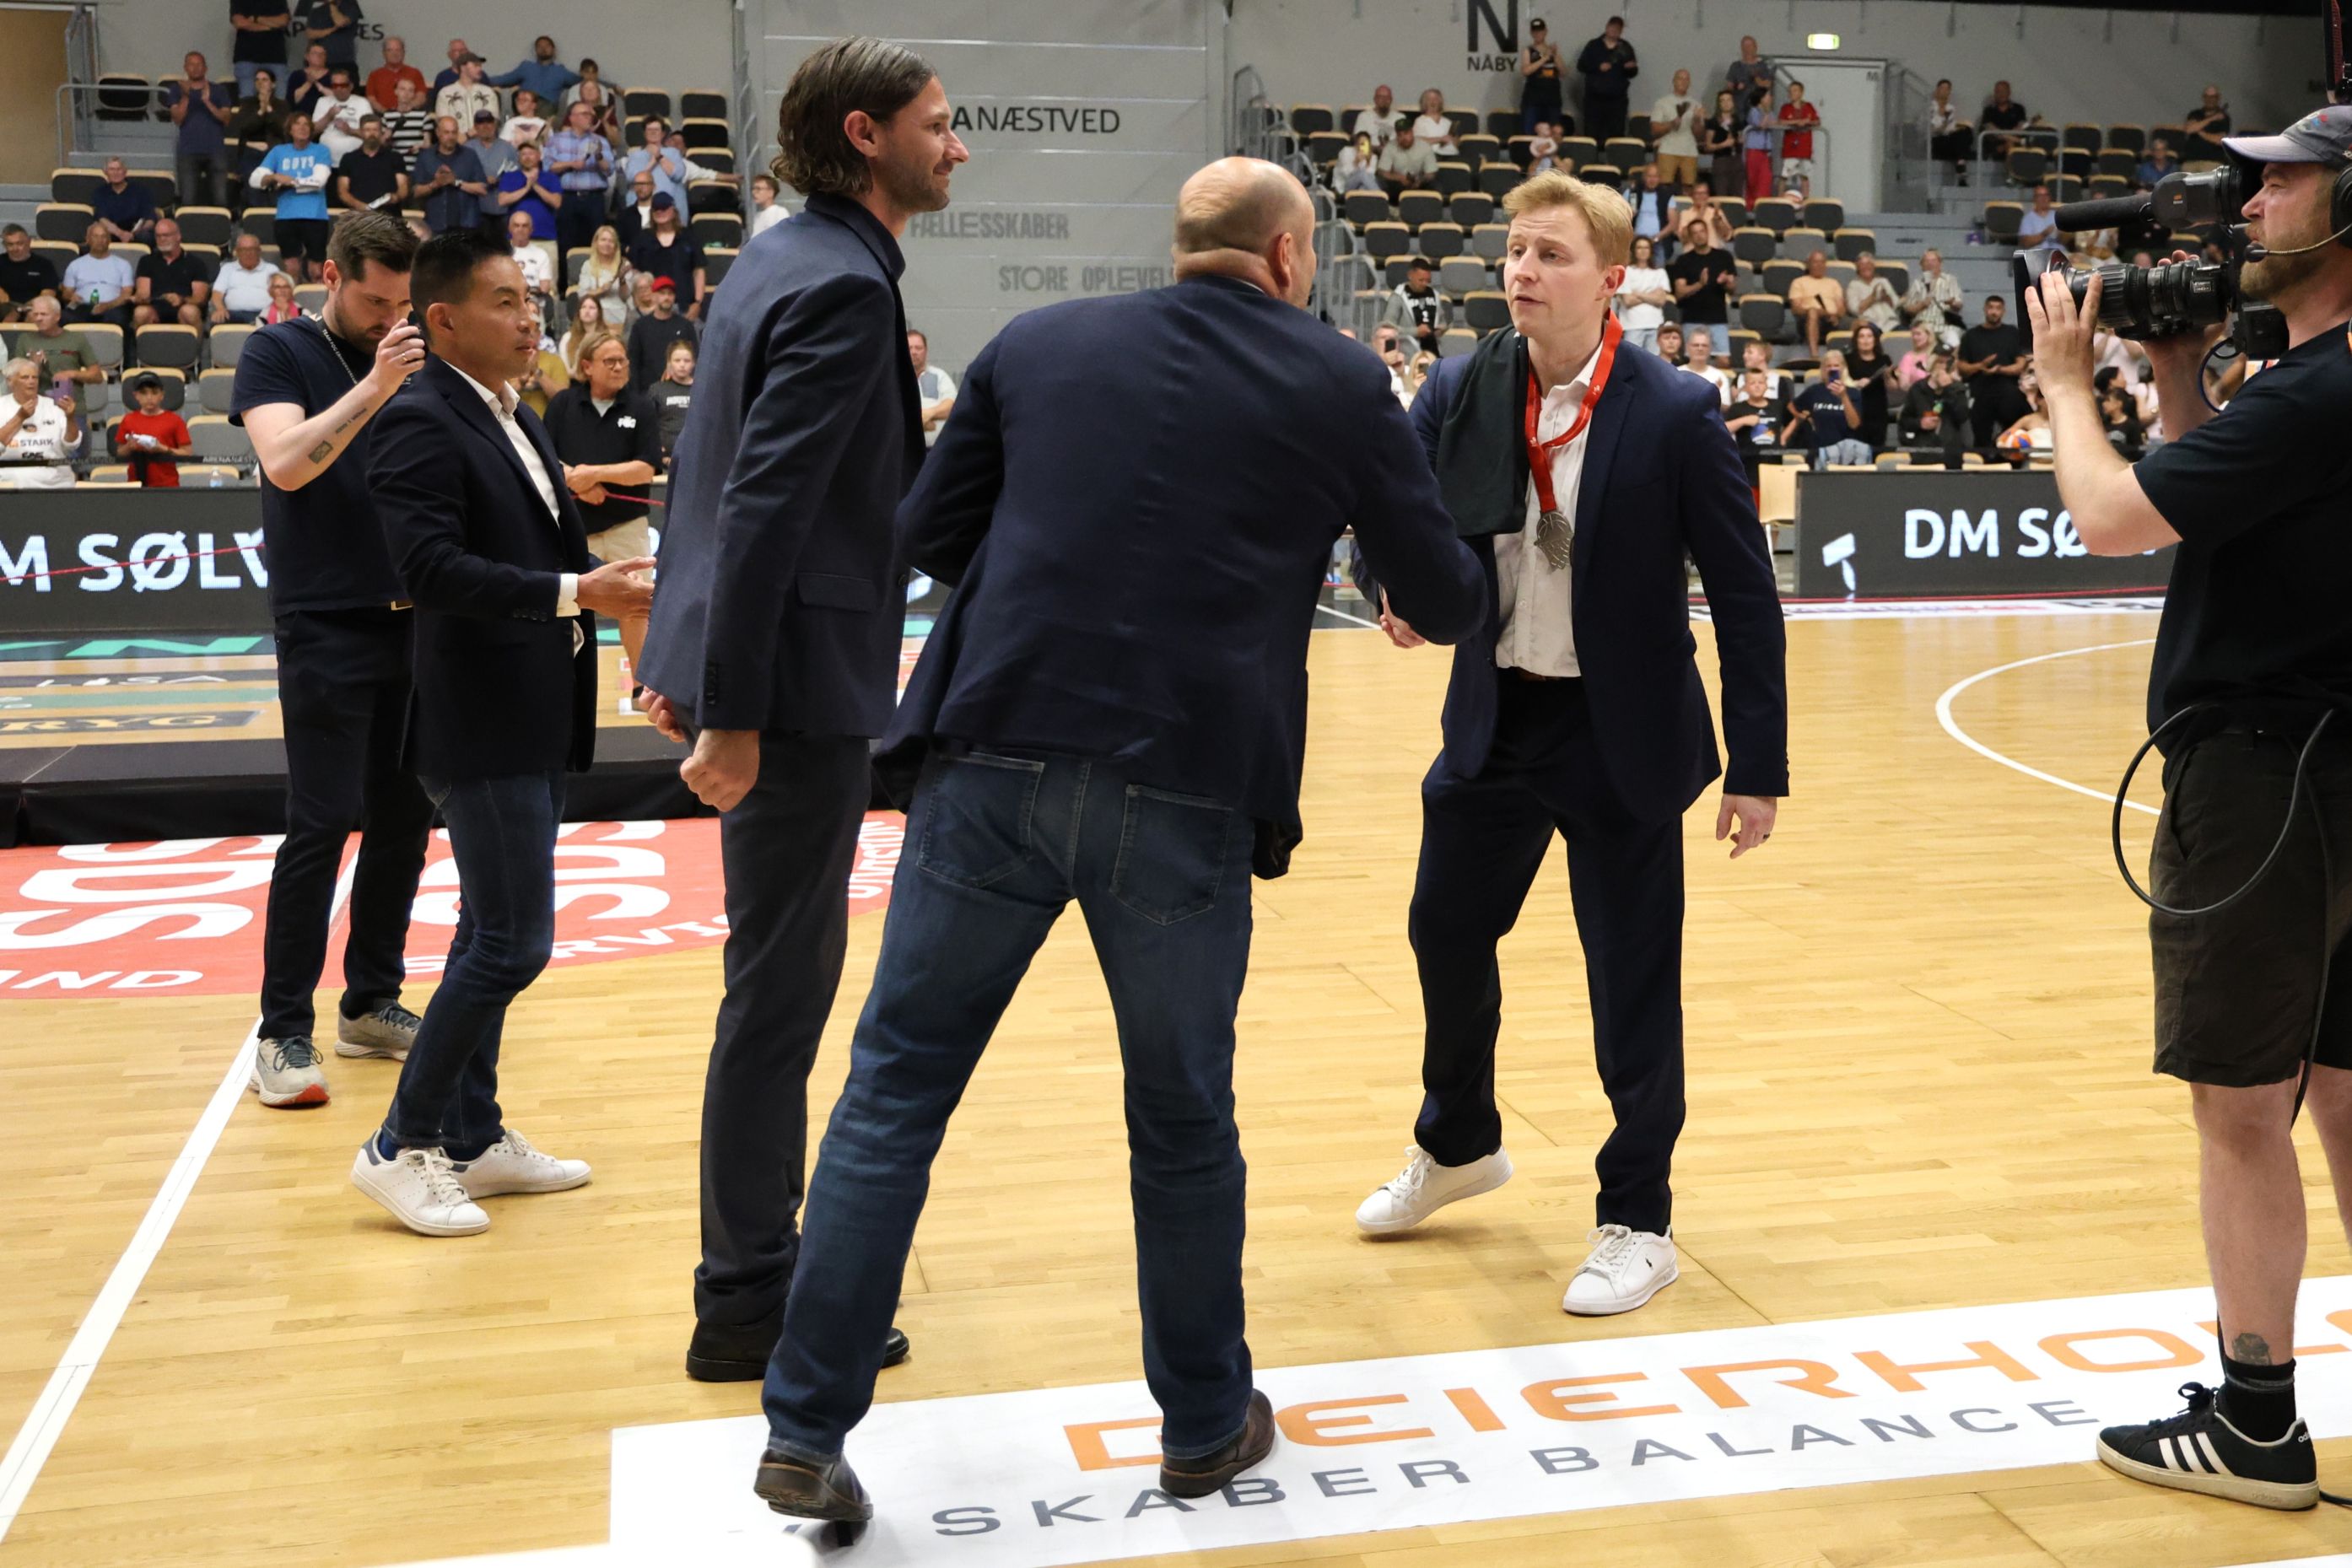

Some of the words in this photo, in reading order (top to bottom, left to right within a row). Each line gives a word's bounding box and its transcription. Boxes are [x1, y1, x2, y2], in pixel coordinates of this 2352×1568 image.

[1468, 0, 1518, 52] N
[1467, 54, 1517, 71] NÅBY
[909, 212, 1069, 240] FÆLLESSKABER
[999, 266, 1068, 292] STORE
[1905, 509, 1999, 558] DM
[931, 1458, 1471, 1536] SKABER
[1529, 1399, 2101, 1475] BALANCE
